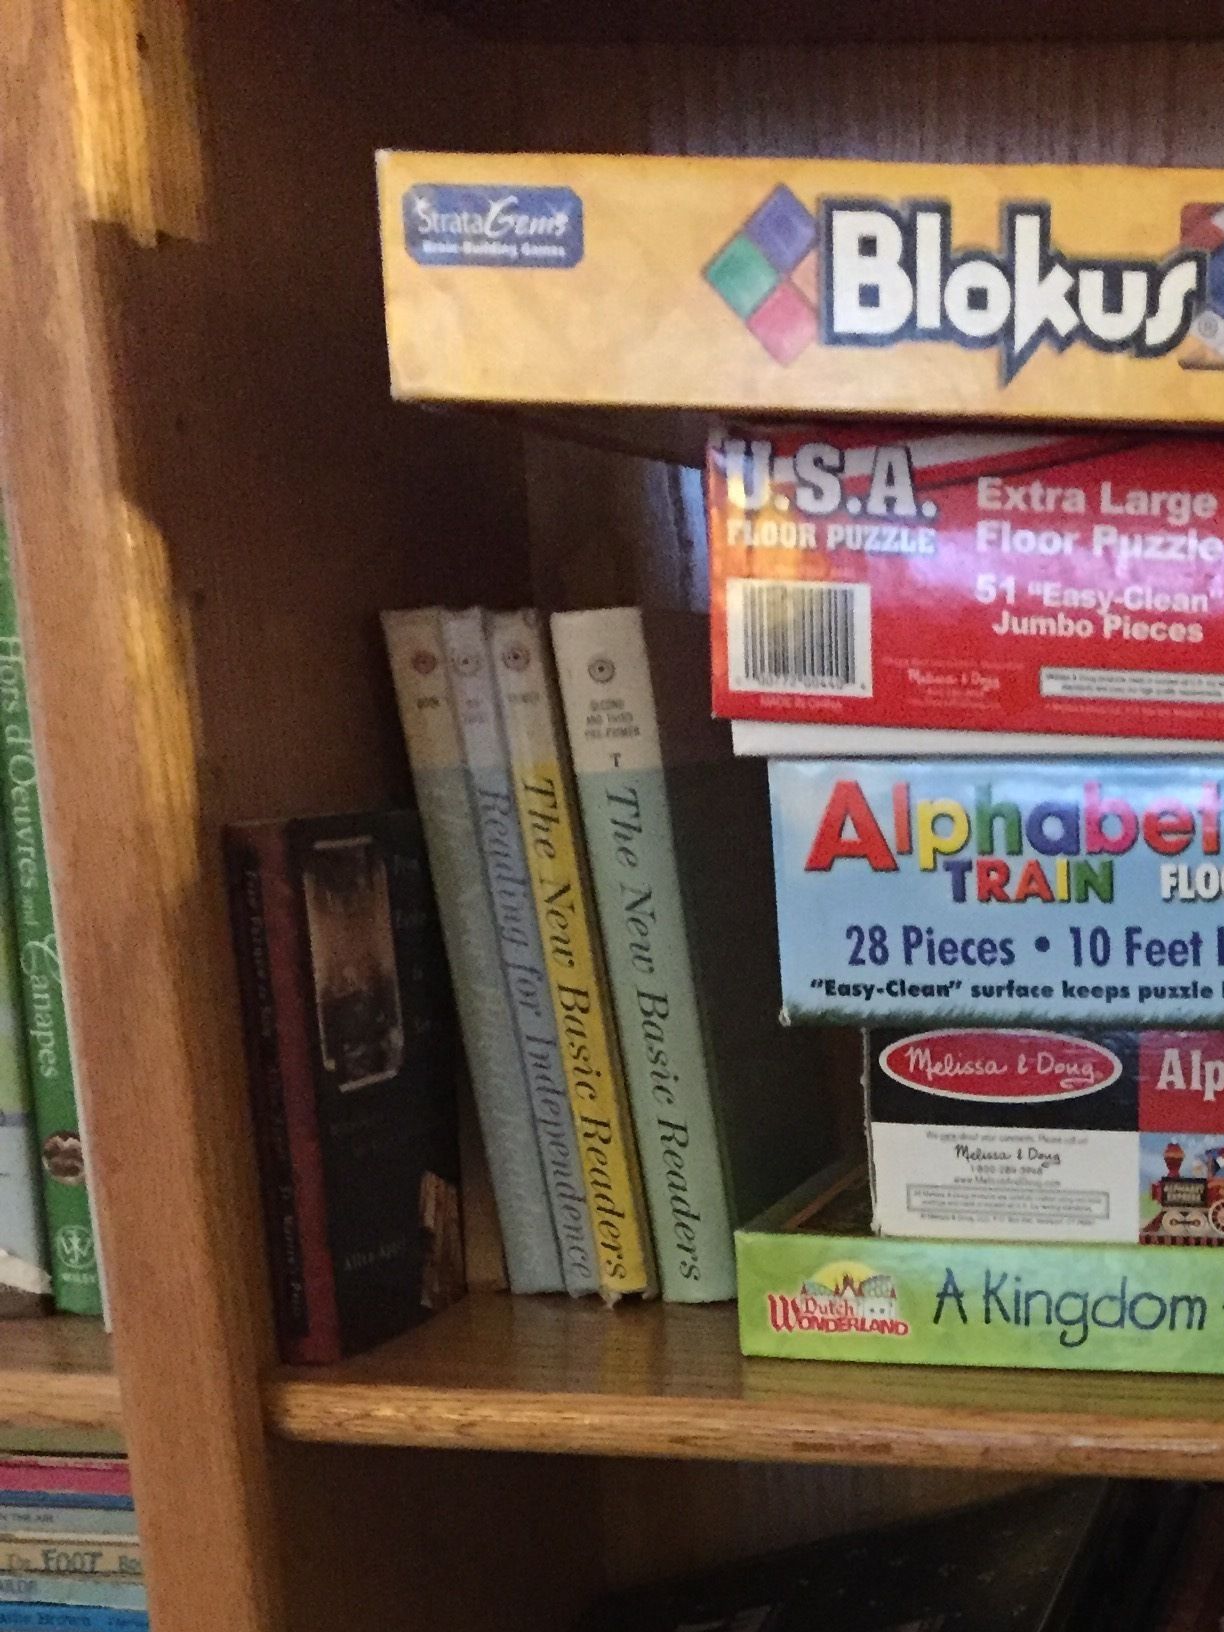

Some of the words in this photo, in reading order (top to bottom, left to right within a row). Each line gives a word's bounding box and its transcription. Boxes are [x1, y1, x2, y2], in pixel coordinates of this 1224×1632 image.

[416, 195, 570, 239] StrataGems
[828, 204, 1203, 385] Blokus
[722, 438, 939, 517] U.S.A.
[977, 476, 1086, 515] Extra
[1100, 480, 1219, 527] Large
[726, 520, 818, 550] FLOOR
[827, 524, 938, 556] PUZZLE
[975, 521, 1077, 557] Floor
[1092, 526, 1224, 566] Puzzle
[975, 575, 1017, 606] 51
[992, 611, 1095, 641] Jumbo
[1102, 615, 1204, 644] Pieces
[4, 726, 42, 890] d'Oeuvres
[522, 776, 561, 861] The
[605, 786, 643, 868] The
[804, 780, 1224, 872] Alphabet
[478, 788, 530, 950] Reading
[943, 859, 1115, 904] TRAIN
[540, 876, 577, 969] New
[618, 883, 658, 974] New
[845, 924, 890, 967] 28
[902, 926, 1016, 968] Pieces
[1069, 926, 1111, 968] 10
[1125, 927, 1205, 968] Feet
[20, 932, 64, 1080] Canapes
[507, 959, 544, 1018] for
[971, 979, 1057, 1000] surface
[1062, 980, 1131, 1004] keeps
[1138, 981, 1213, 1004] puzzle
[556, 983, 602, 1103] Basic
[635, 983, 680, 1106] Basic
[904, 1046, 1009, 1080] Melissa
[1036, 1051, 1097, 1091] Doug
[525, 1033, 593, 1280] Independence
[954, 1143, 1012, 1163] Melissa
[1027, 1147, 1062, 1168] Doug
[580, 1114, 628, 1281] Readers
[657, 1115, 702, 1283] Readers
[768, 1294, 910, 1336] WONDERLAND
[803, 1295, 855, 1317] Dutch
[932, 1266, 969, 1326] A
[983, 1267, 1208, 1348] Kingdom
[41, 1547, 104, 1574] FOOT
